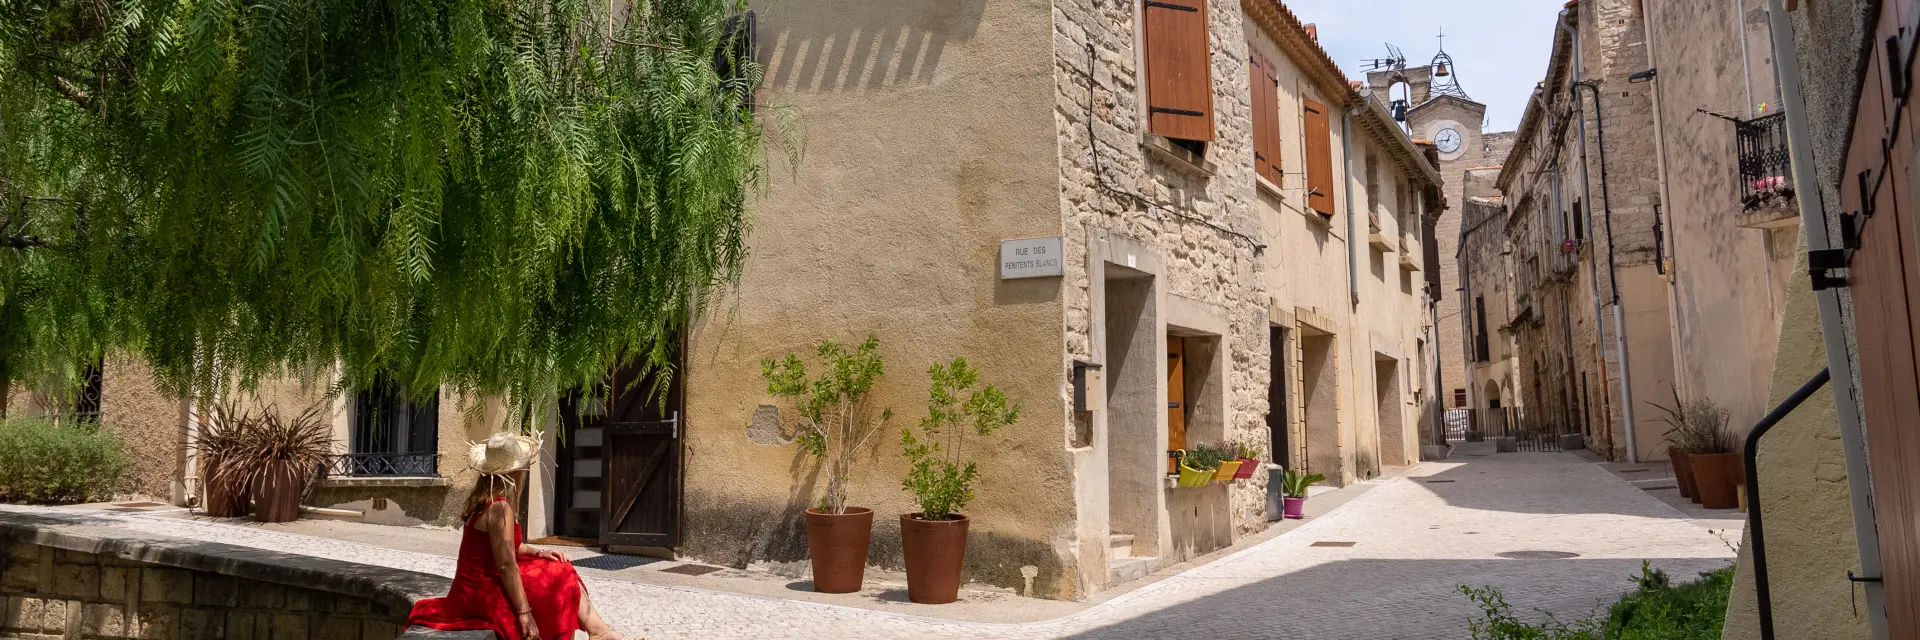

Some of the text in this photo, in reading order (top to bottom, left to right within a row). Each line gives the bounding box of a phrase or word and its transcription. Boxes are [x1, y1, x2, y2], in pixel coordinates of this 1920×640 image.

[1016, 246, 1046, 256] RUE DES
[1005, 258, 1058, 270] PENITENTS BLANCS
